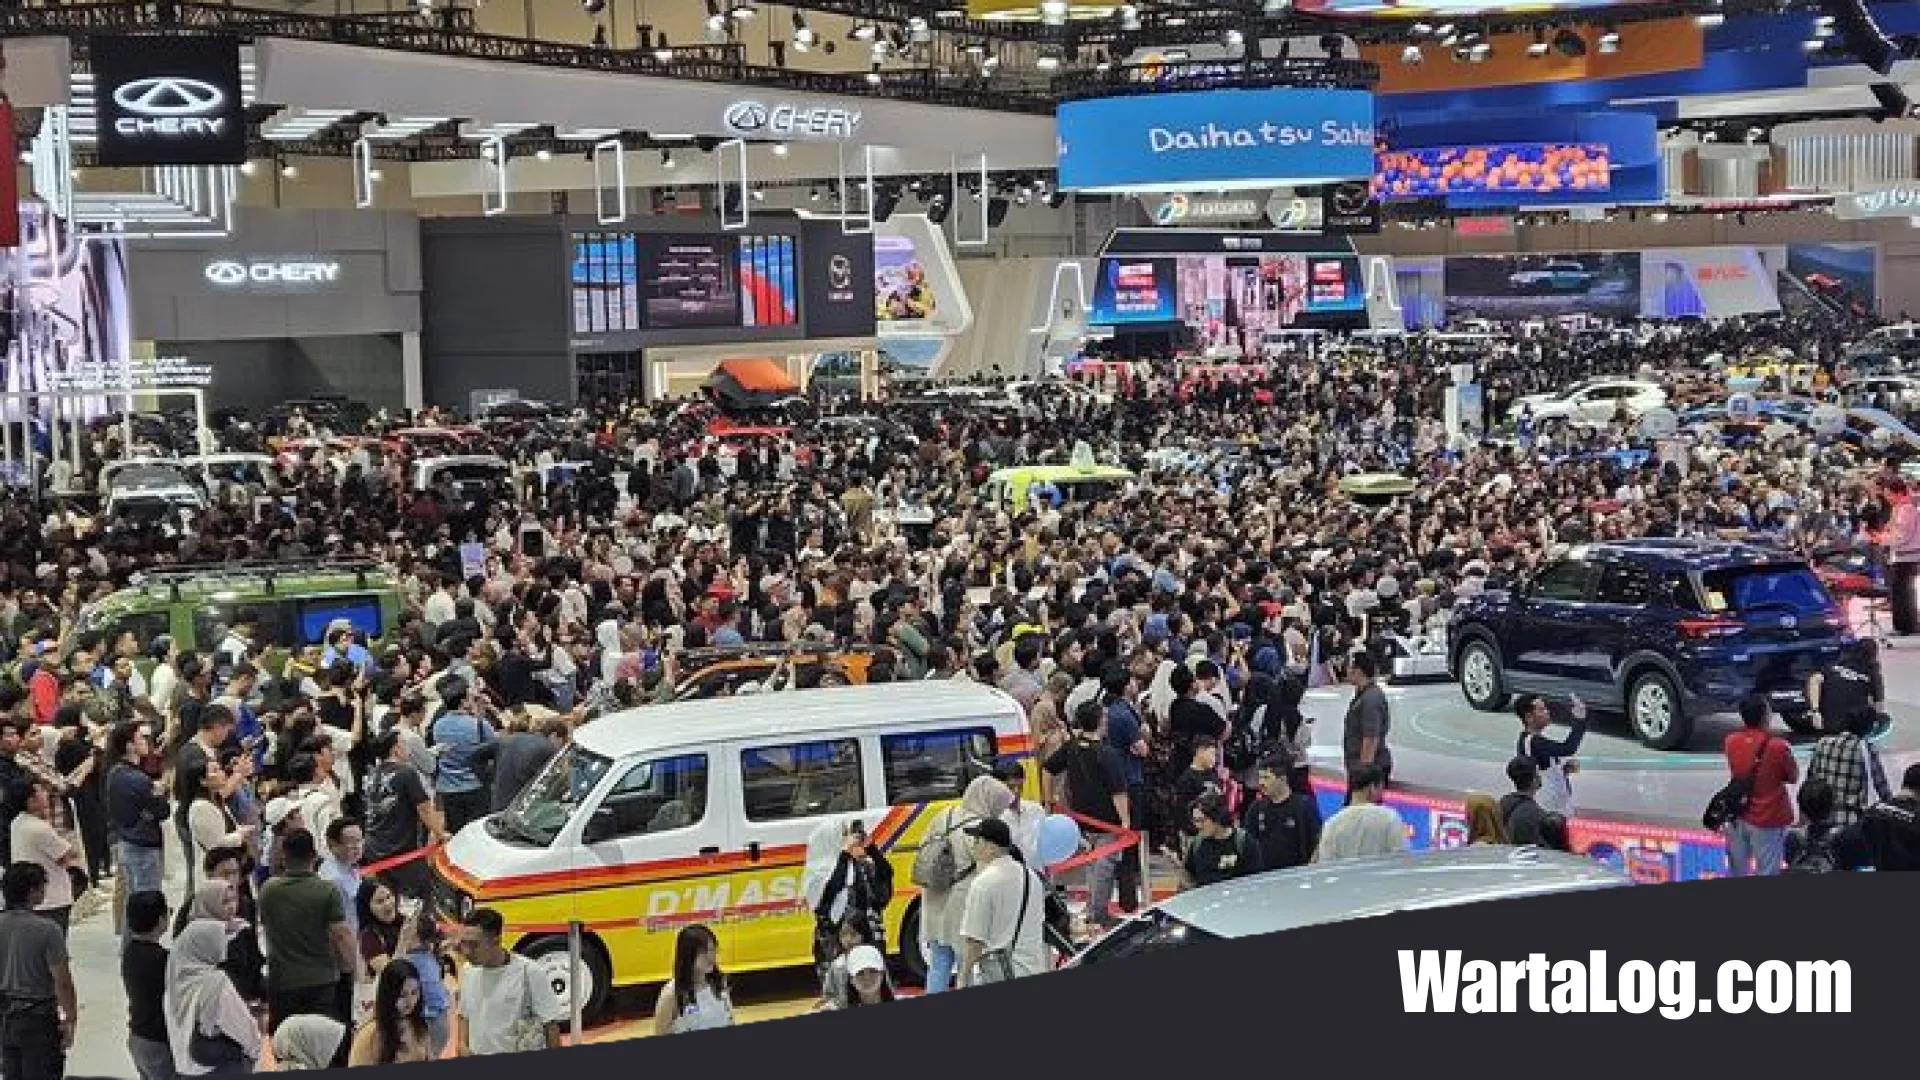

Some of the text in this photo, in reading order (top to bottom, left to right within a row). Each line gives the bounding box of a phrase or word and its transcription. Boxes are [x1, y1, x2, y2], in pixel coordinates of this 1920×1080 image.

[115, 117, 225, 134] CHERY
[771, 105, 861, 137] CHERY
[1150, 121, 1313, 152] Daihatsu
[249, 262, 340, 281] CHERY
